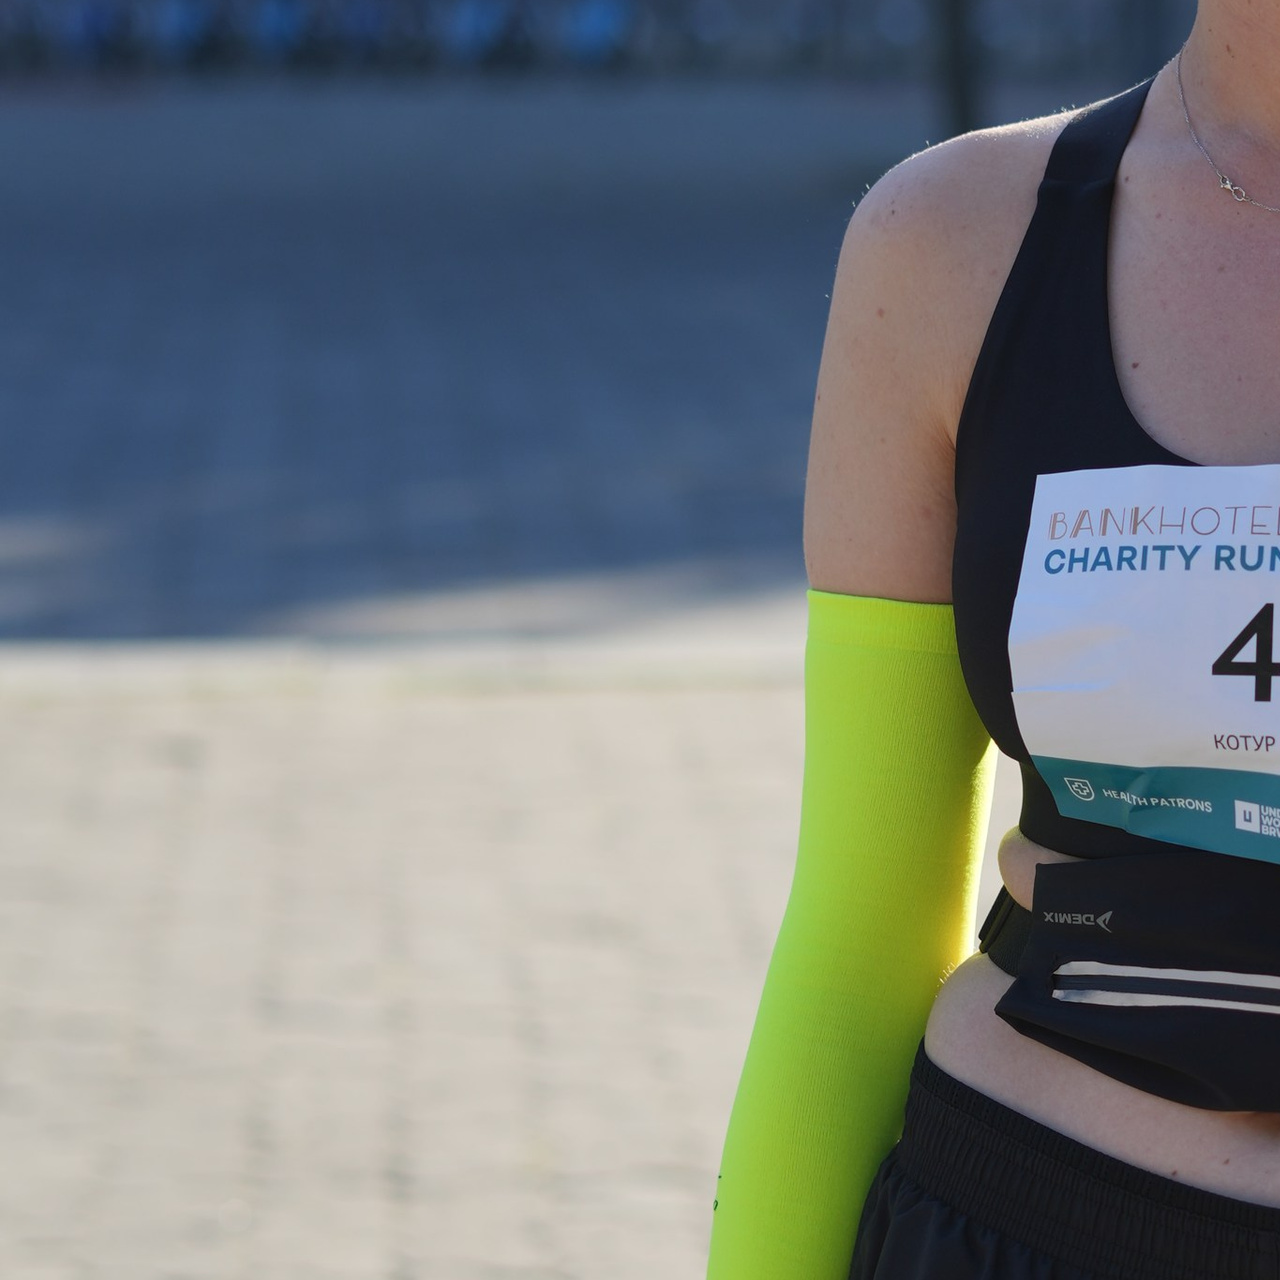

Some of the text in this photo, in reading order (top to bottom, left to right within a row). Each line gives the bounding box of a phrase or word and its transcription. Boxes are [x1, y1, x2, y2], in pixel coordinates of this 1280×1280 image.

[1044, 545, 1202, 575] CHARITY
[1213, 734, 1276, 752] КОТУР
[1102, 788, 1213, 813] HEALTH PATRONS
[1043, 911, 1096, 926] DEMIX
